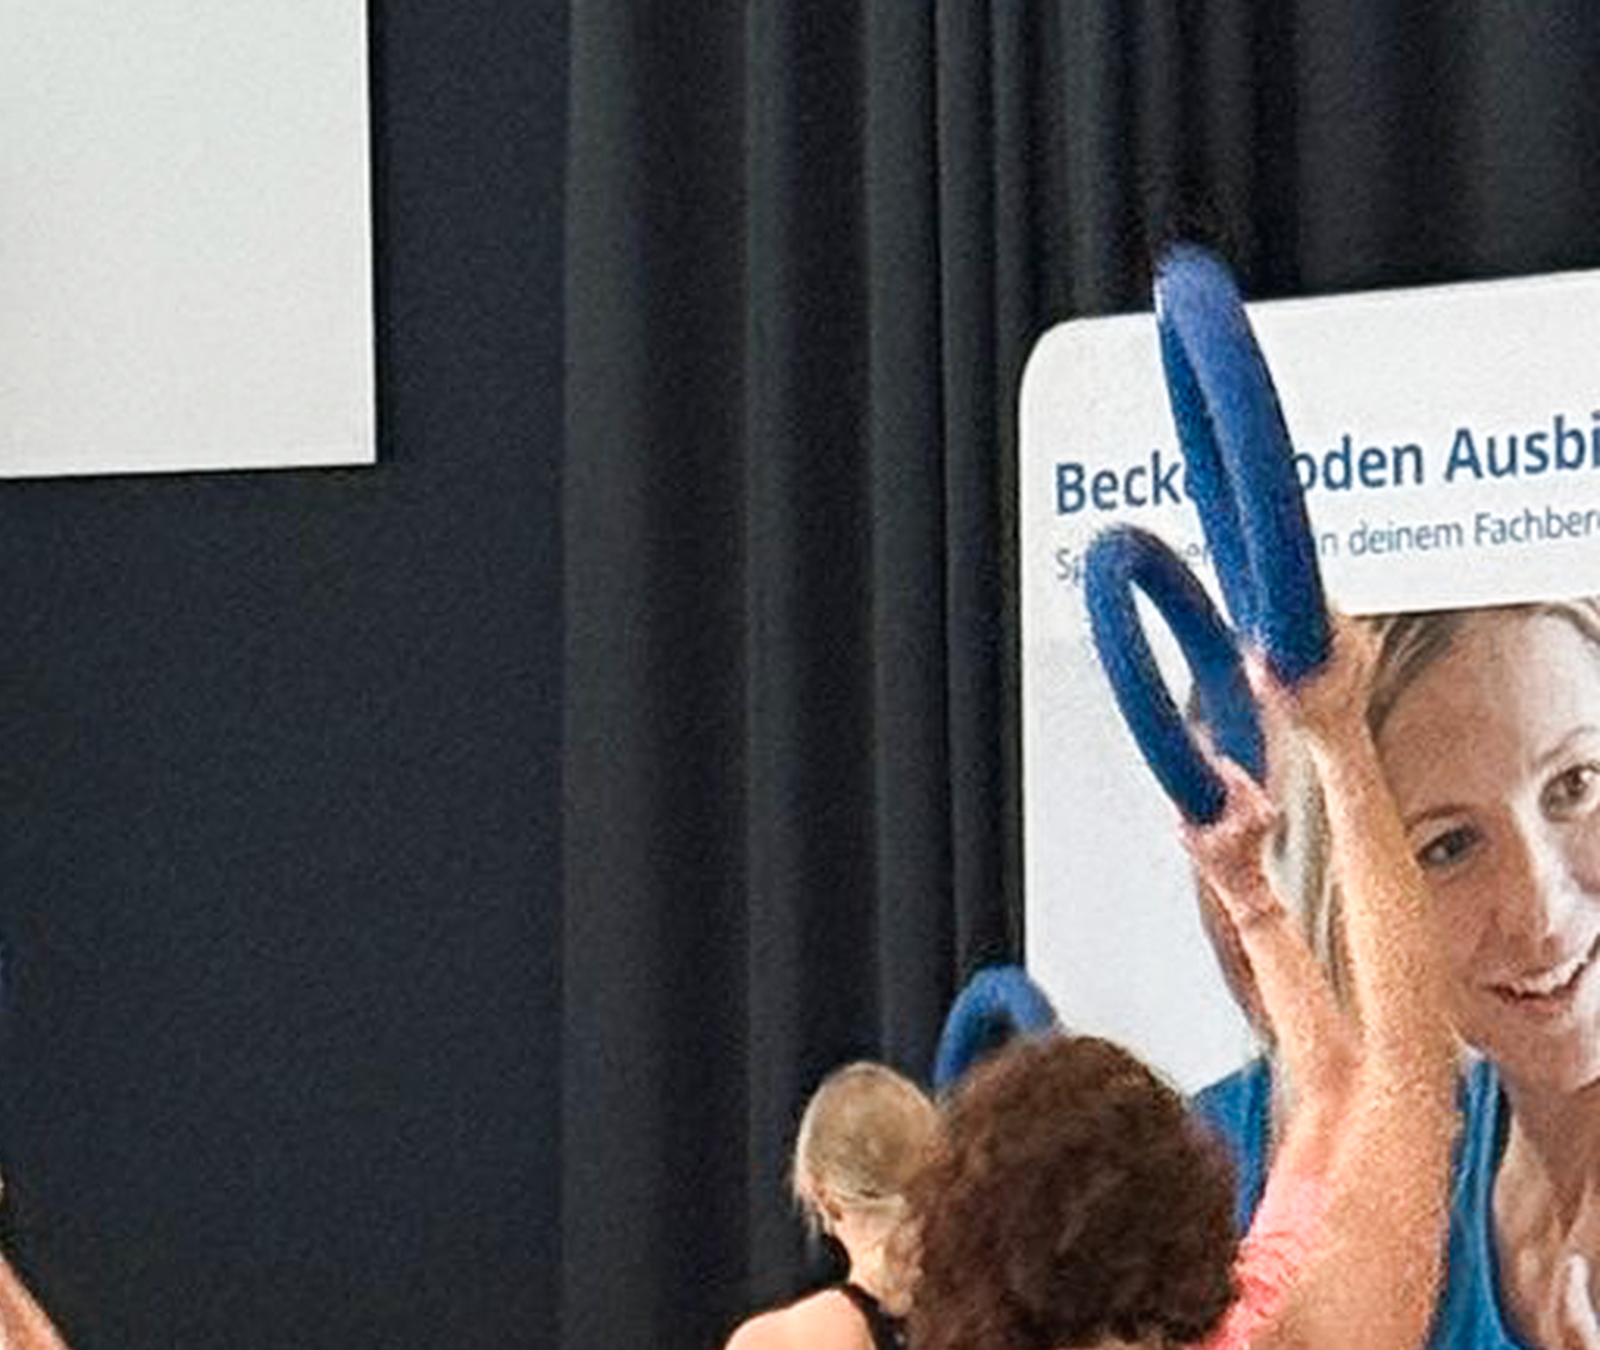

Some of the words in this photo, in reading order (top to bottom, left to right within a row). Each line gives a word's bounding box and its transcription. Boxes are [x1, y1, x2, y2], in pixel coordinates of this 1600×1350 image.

[1055, 433, 1424, 516] Beckoden
[1348, 517, 1464, 557] deinem
[1474, 503, 1600, 547] Fachber
